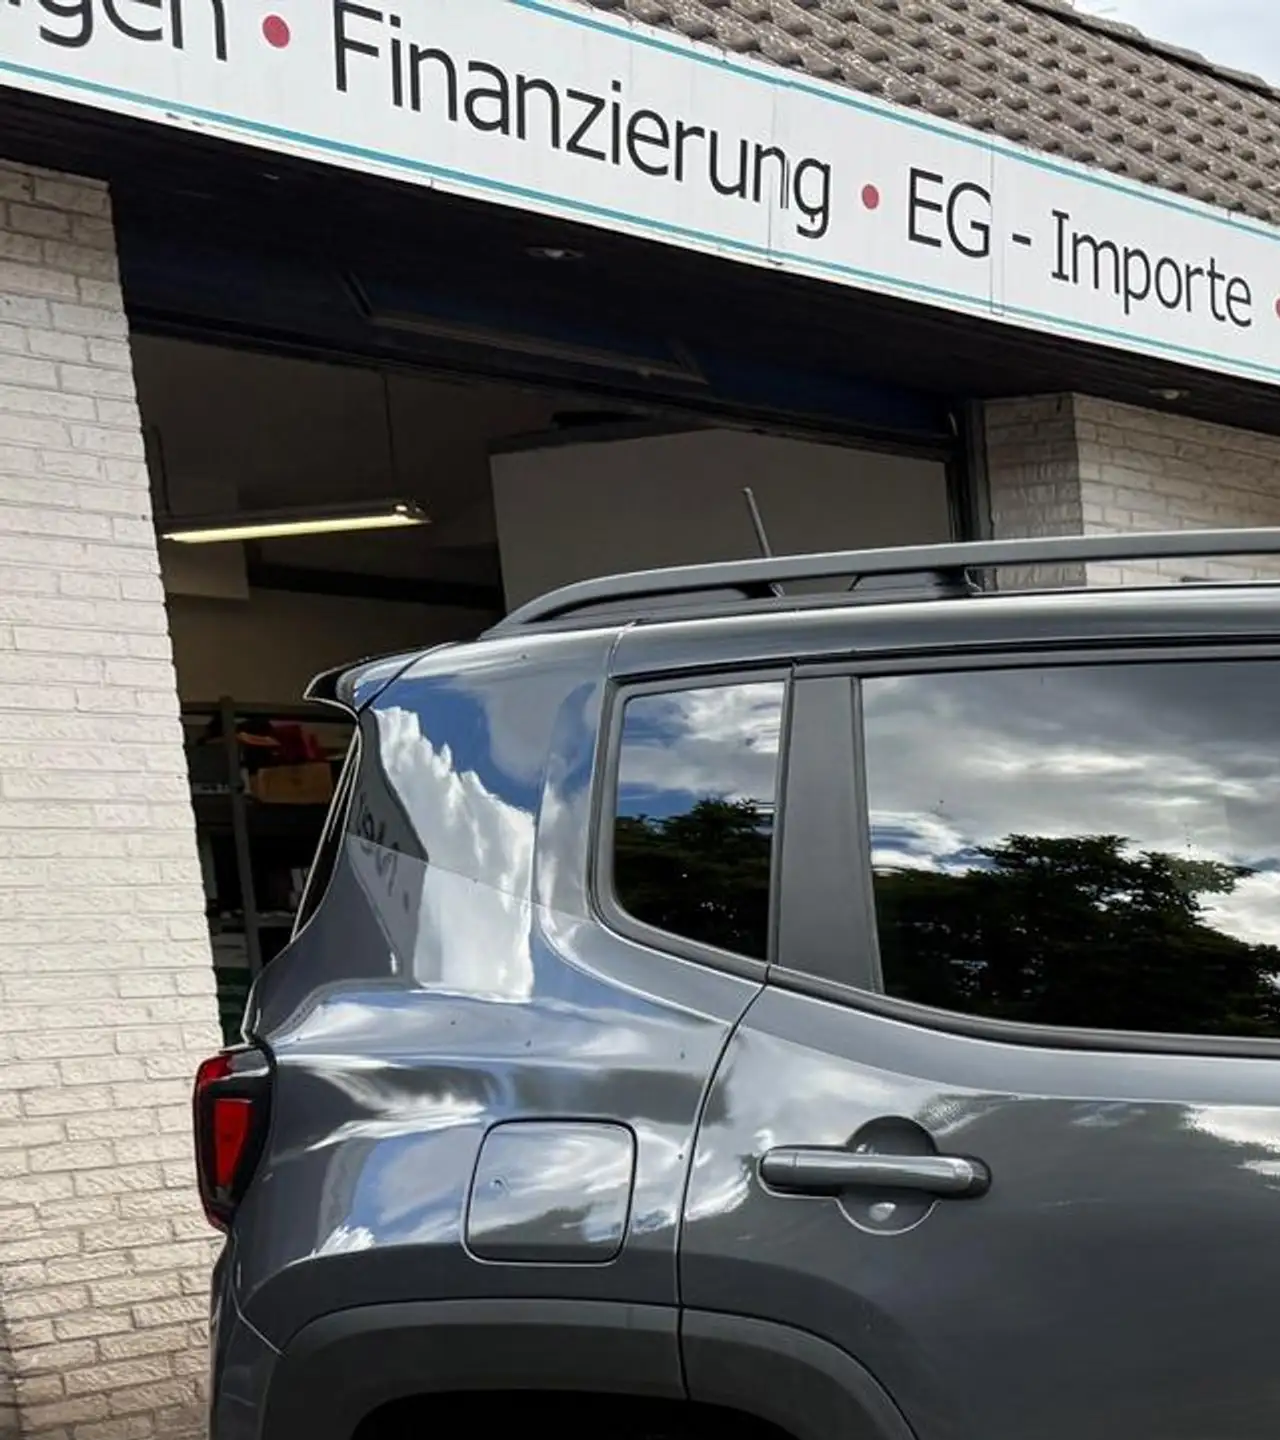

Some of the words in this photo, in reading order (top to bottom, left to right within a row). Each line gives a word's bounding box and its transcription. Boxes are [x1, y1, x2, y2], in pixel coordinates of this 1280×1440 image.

[333, 2, 832, 238] Finanzierung
[908, 167, 991, 259] EG
[1051, 209, 1252, 327] Importe
